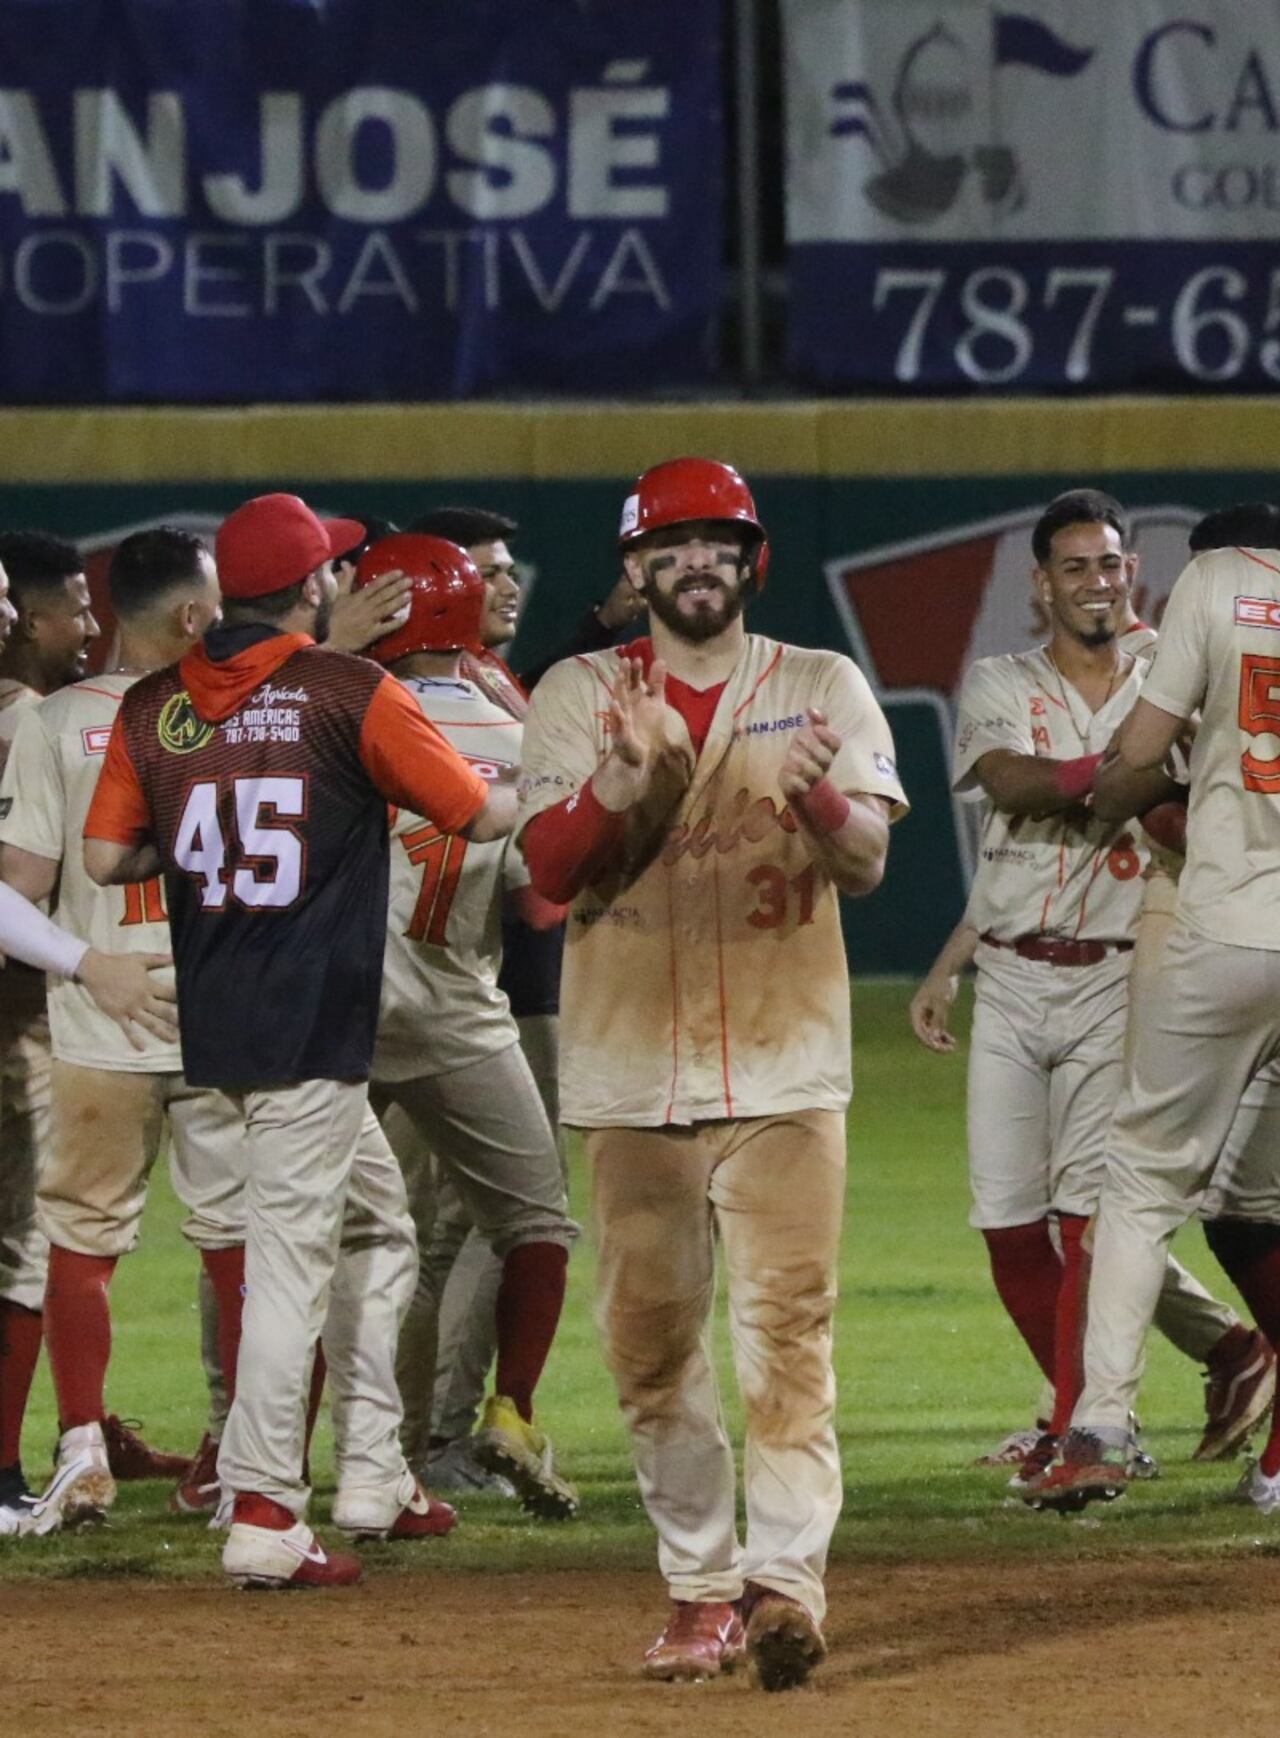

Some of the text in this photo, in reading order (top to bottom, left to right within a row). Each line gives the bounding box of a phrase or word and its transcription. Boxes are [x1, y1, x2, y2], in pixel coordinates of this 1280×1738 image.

[0, 230, 673, 317] OPERATIVA
[172, 776, 304, 908] 45
[745, 864, 815, 929] 31
